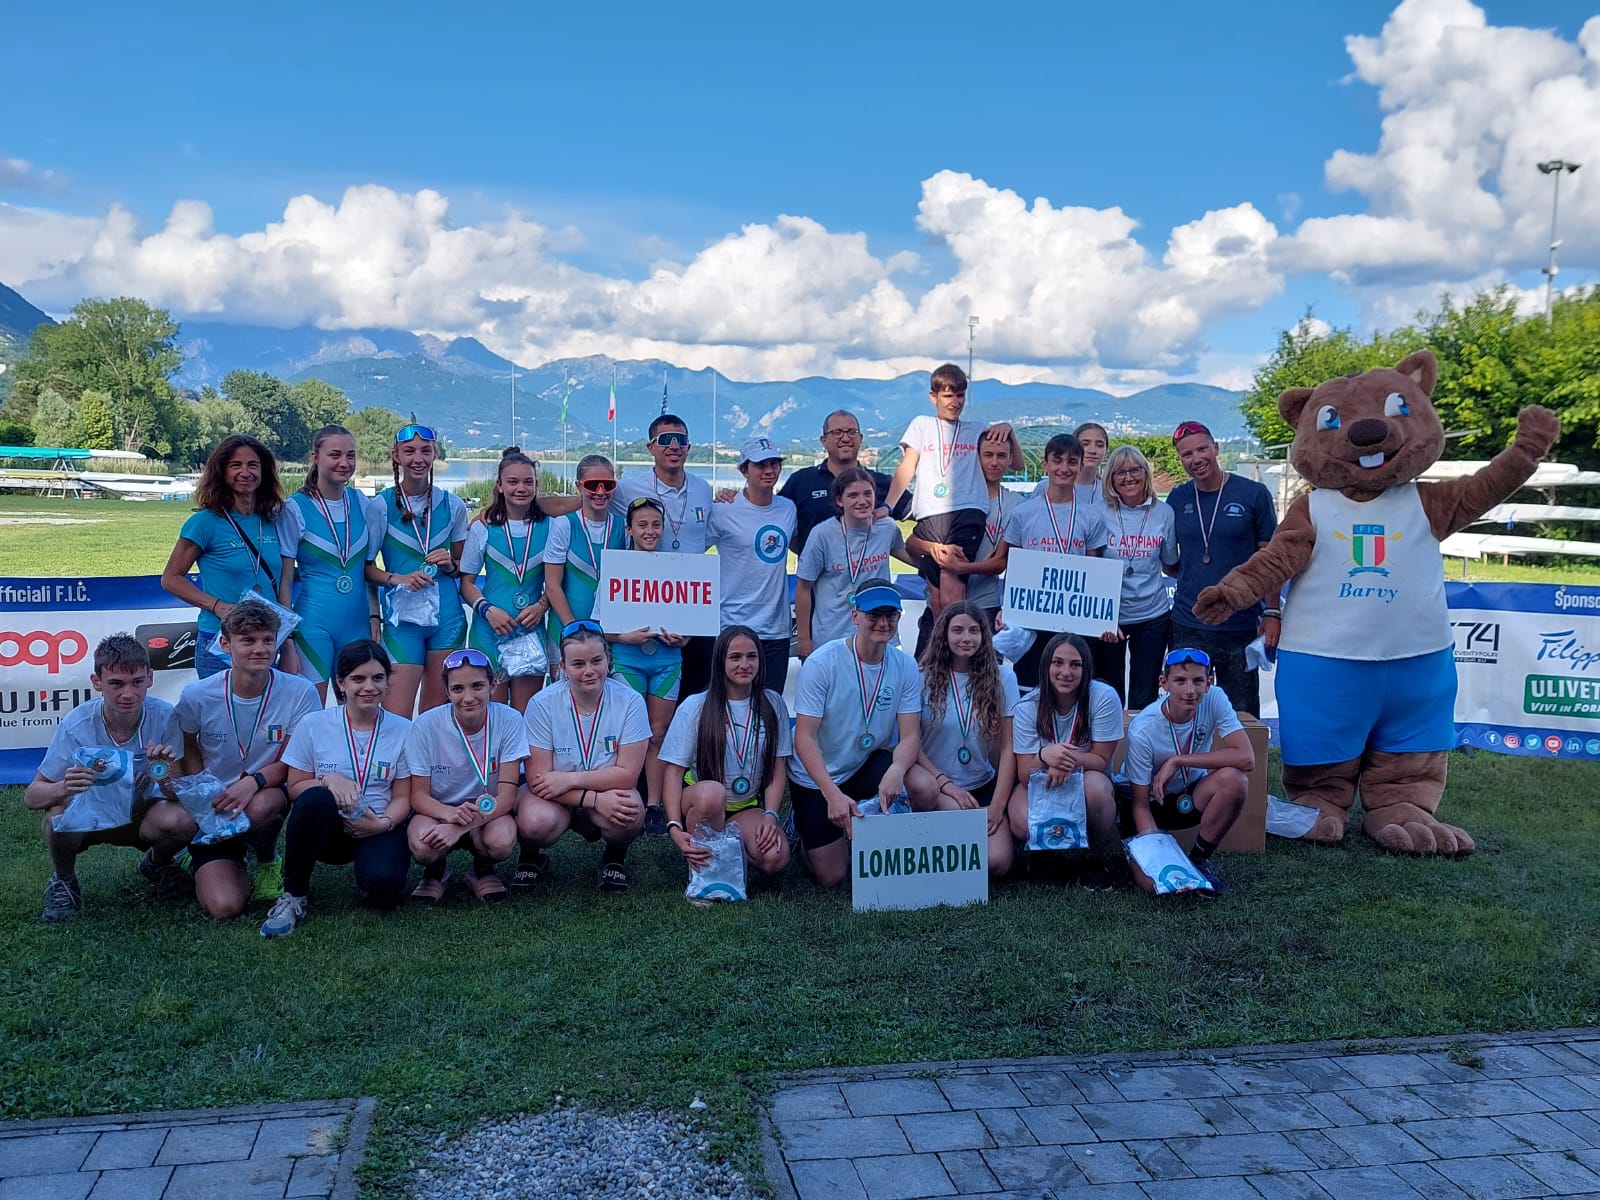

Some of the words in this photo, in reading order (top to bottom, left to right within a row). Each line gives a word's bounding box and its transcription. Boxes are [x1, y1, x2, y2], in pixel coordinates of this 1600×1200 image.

[609, 578, 712, 605] PIEMONTE
[1041, 566, 1087, 594] FRIULI
[1338, 582, 1399, 603] Barvy
[1010, 587, 1064, 615] VENEZIA
[1068, 594, 1114, 621] GIULIA
[22, 716, 52, 727] from
[859, 843, 981, 879] LOMBARDIA
